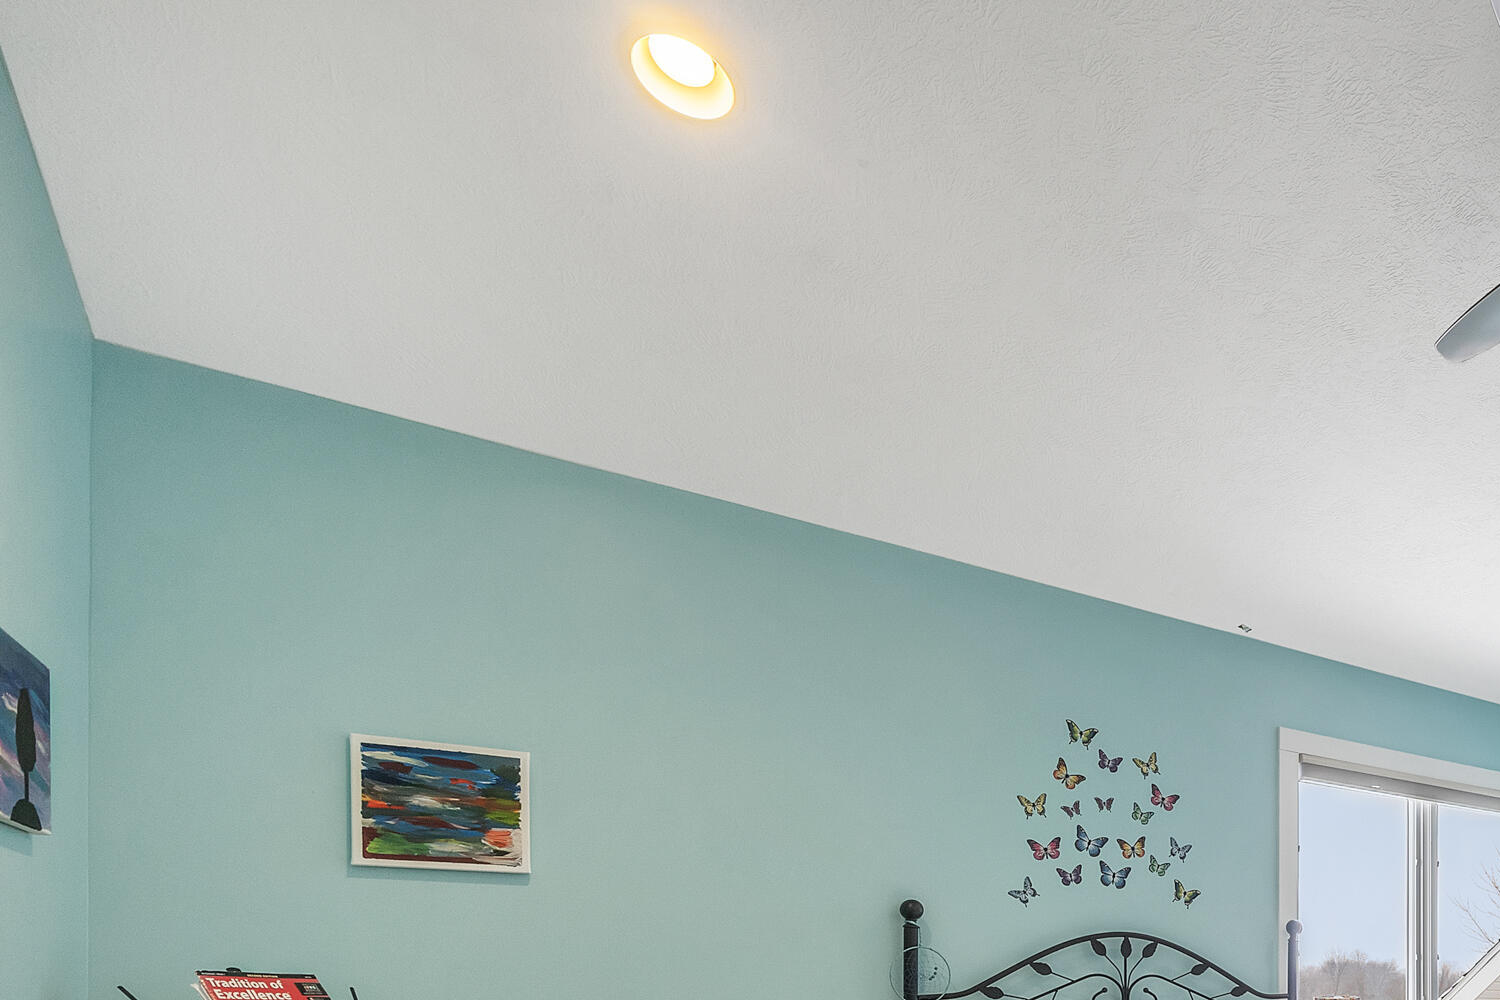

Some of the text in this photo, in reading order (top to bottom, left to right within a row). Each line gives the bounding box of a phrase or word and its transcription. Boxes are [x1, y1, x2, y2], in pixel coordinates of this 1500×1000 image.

[205, 977, 284, 989] Tradition of
[213, 988, 292, 1000] Excellence
